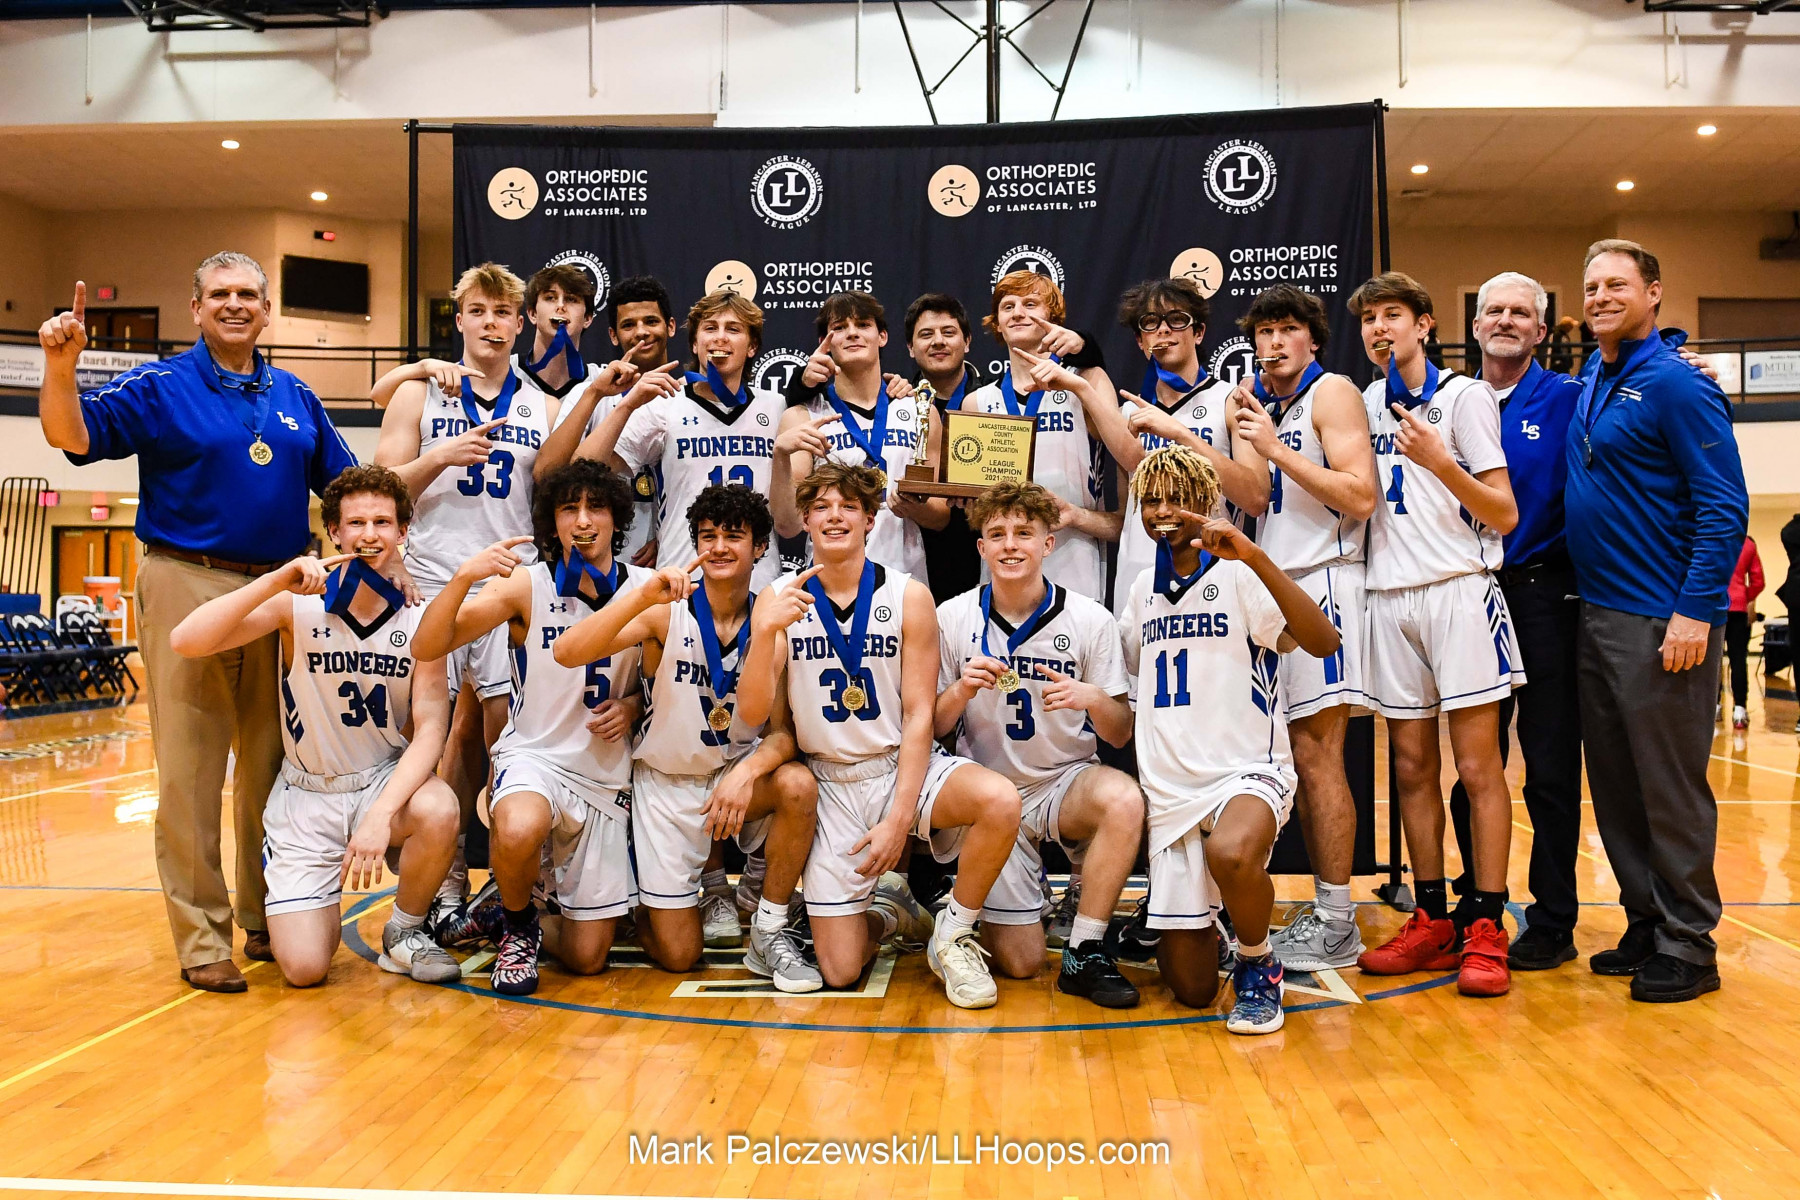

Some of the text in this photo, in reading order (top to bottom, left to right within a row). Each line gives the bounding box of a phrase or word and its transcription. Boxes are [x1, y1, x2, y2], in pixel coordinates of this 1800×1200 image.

[1202, 139, 1277, 179] LANCASTER LEBANON
[545, 169, 648, 184] ORTHOPEDIC
[750, 154, 823, 193] LANCASTER LEBANON
[986, 162, 1096, 181] ORTHOPEDIC
[543, 187, 648, 202] ASSOCIATES
[985, 180, 1096, 198] ASSOCIATES
[545, 207, 647, 217] OF LANCASTER, LTD
[987, 200, 1097, 213] OF LANCASTER, LTD
[1218, 200, 1265, 215] LEAGUE
[764, 216, 810, 230] LEAGUE
[990, 244, 1065, 284] LANCASTER LEBANON
[1229, 244, 1338, 264] ORTHOPEDIC
[584, 250, 611, 288] LEBANON
[763, 261, 873, 278] ORTHOPEDIC
[1228, 263, 1338, 282] ASSOCIATES
[762, 279, 873, 295] ASSOCIATES
[1231, 288, 1245, 296] OF
[1320, 284, 1338, 293] LTD
[764, 300, 826, 309] OF LANCAS
[1207, 335, 1245, 376] LANCASTER
[431, 417, 542, 450] PIOERS
[1521, 420, 1540, 440] LS
[677, 435, 774, 459] PIONEERS
[826, 428, 918, 454] PIOERS
[986, 446, 1018, 454] ASSOCIATION
[990, 438, 1016, 446] ATHLETIC
[457, 450, 515, 499] 33
[981, 466, 1022, 476] CHAMPION
[1142, 613, 1229, 647] PIONEERS
[791, 633, 899, 661] PIOERS
[307, 651, 411, 678] PIONEERS
[1154, 648, 1191, 708] 11
[338, 681, 388, 728] 34
[819, 667, 881, 723] 30
[1005, 688, 1036, 741] 3
